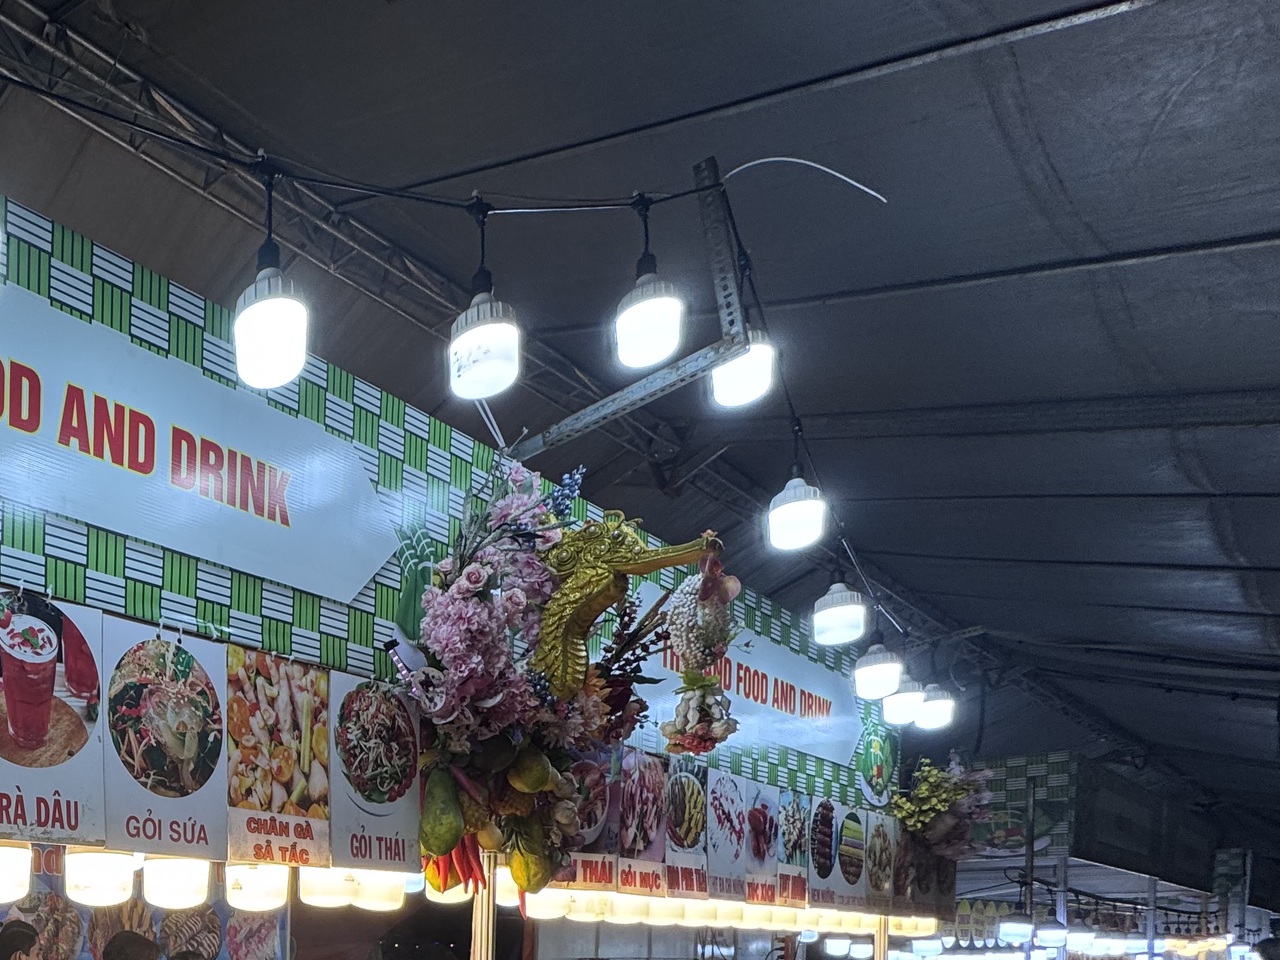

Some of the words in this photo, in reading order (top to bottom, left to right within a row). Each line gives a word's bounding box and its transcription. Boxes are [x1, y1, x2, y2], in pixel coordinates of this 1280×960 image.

[57, 381, 156, 476] AND
[170, 424, 292, 527] DRINK
[736, 661, 768, 705] FOOD
[772, 677, 796, 715] AND
[800, 688, 832, 719] DRINK
[36, 789, 79, 831] DÂU
[125, 809, 162, 841] GỎI
[169, 816, 209, 846] SỨA
[246, 816, 290, 839] CHÂN
[293, 818, 315, 841] GÀ
[253, 843, 275, 862] SẢ
[279, 843, 310, 865] TẮC
[350, 826, 372, 860] GỎI
[376, 831, 406, 863] THÁI
[581, 856, 613, 884] THÁI
